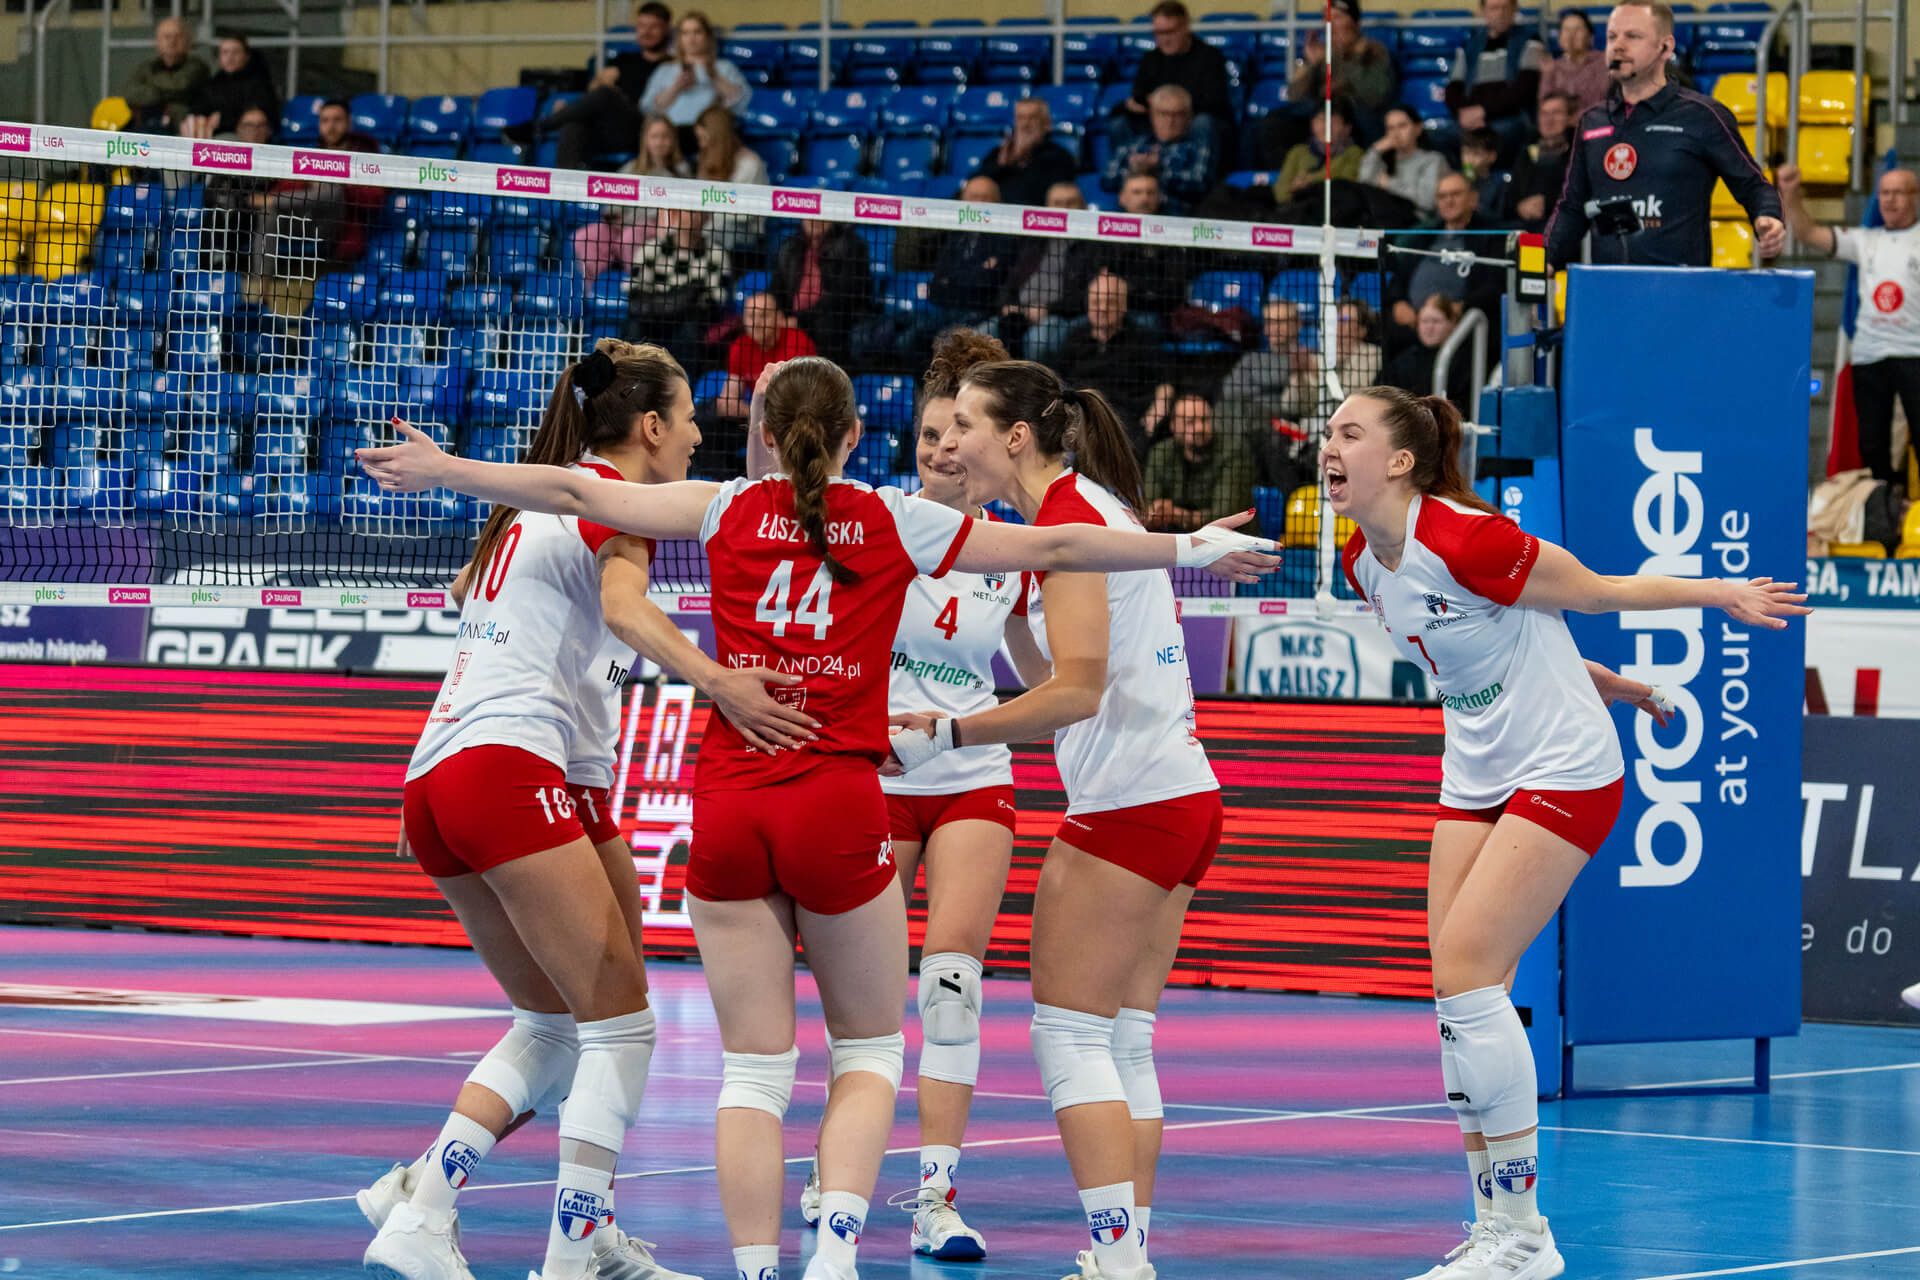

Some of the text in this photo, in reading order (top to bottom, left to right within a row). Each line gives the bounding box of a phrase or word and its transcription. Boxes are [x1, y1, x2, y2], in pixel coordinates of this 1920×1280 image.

[42, 136, 65, 149] LIGA
[106, 136, 138, 159] plus
[211, 151, 248, 164] TAURON
[309, 159, 382, 175] TAURON LIGA
[419, 161, 447, 184] plus
[513, 175, 547, 188] TAURON
[603, 182, 636, 196] TAURON
[701, 186, 728, 206] plus
[787, 197, 818, 209] TAURON
[757, 512, 864, 545] ŁUSZYSKA
[35, 586, 58, 603] plus
[121, 591, 148, 601] TAURON
[191, 588, 213, 605] plus
[340, 589, 361, 606] plus
[755, 559, 834, 640] 44
[934, 596, 960, 641] 4
[1407, 635, 1439, 676] 7
[1620, 427, 1705, 888] brother
[1712, 510, 1759, 806] at your ide
[1259, 665, 1347, 697] KALISZ
[1846, 919, 1893, 955] do
[1506, 1159, 1529, 1168] MKS
[573, 1192, 597, 1205] MKS
